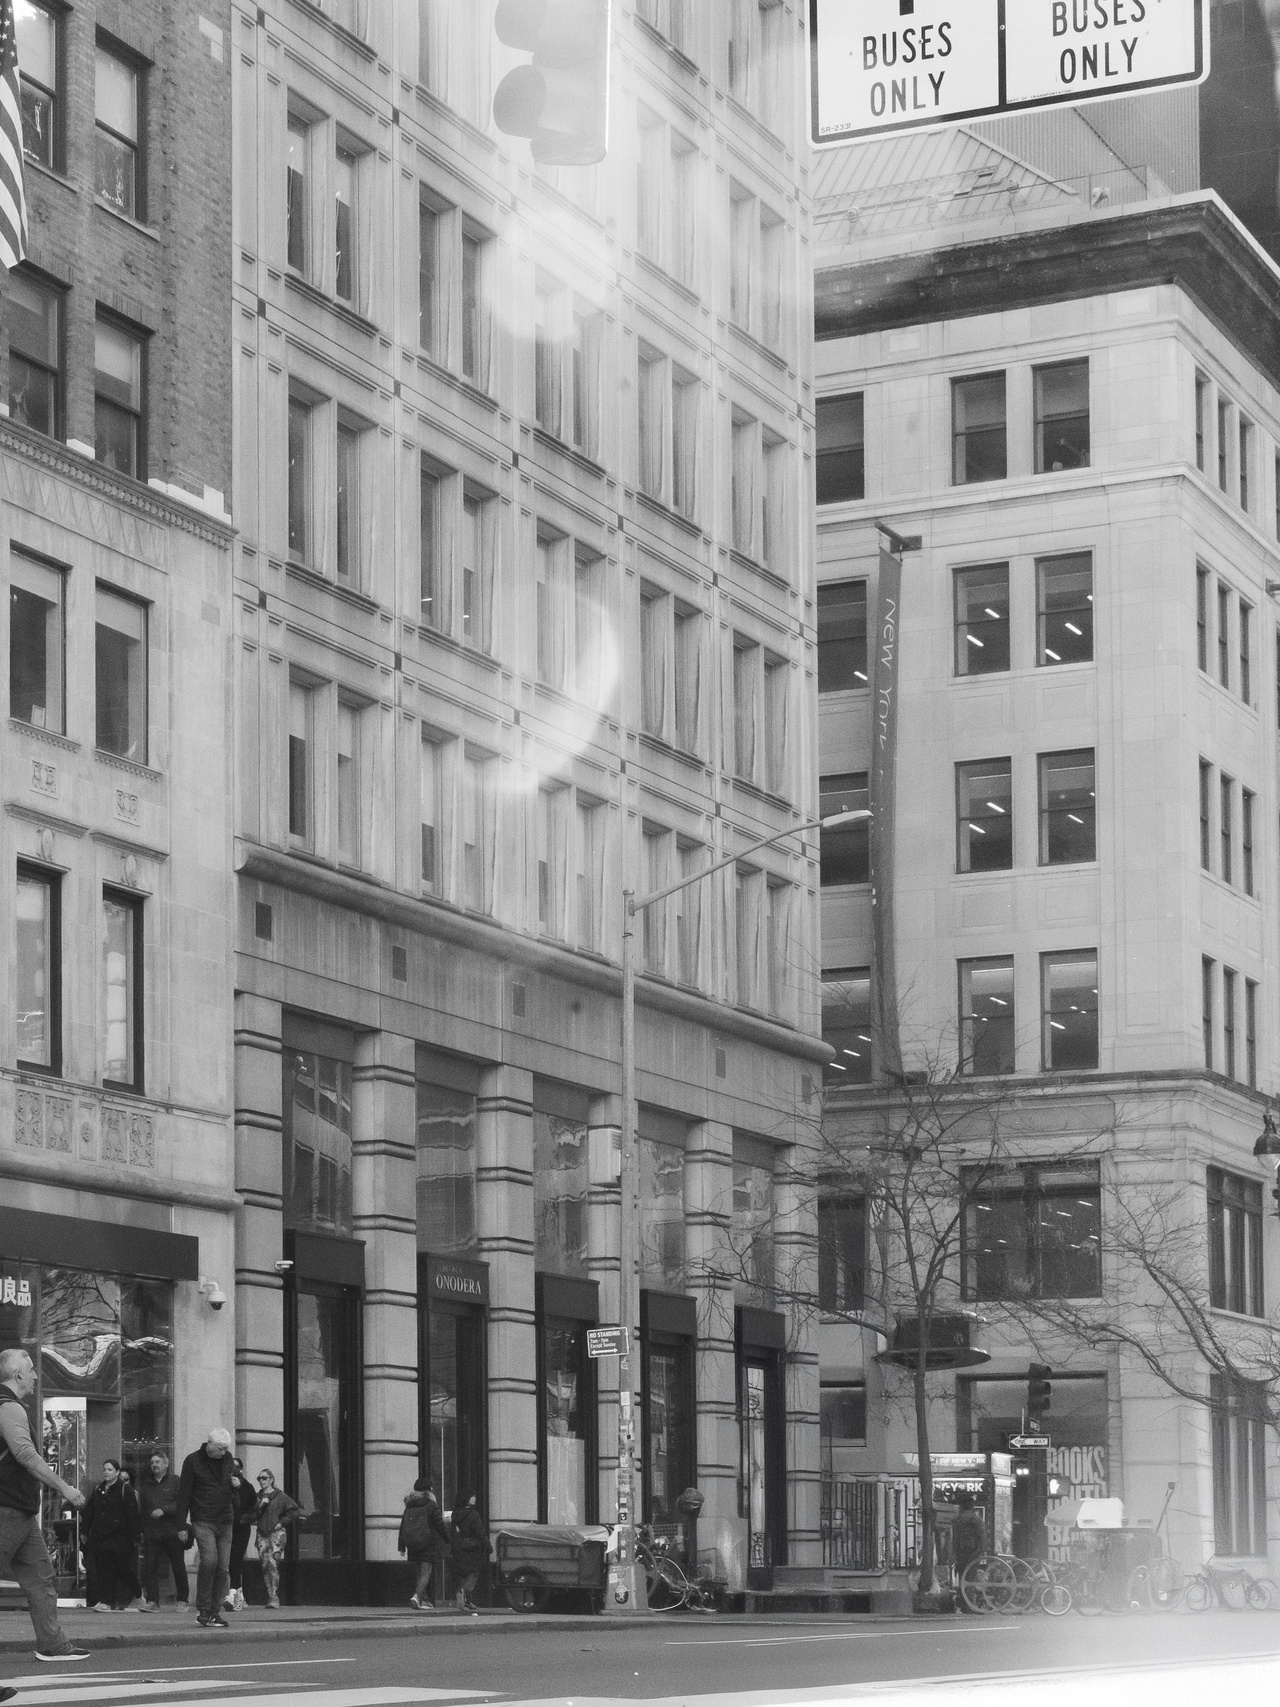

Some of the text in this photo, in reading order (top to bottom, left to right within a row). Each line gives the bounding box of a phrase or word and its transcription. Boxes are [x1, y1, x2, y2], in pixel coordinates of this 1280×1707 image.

[1052, 0, 1146, 37] BUSES
[863, 22, 953, 71] BUSES
[1060, 37, 1139, 84] ONLY
[870, 71, 946, 117] ONLY
[435, 1273, 482, 1295] ONODERA
[597, 1330, 621, 1338] STANDING
[1014, 1437, 1047, 1445] ONE WAY
[1047, 1446, 1106, 1484] BOOKS
